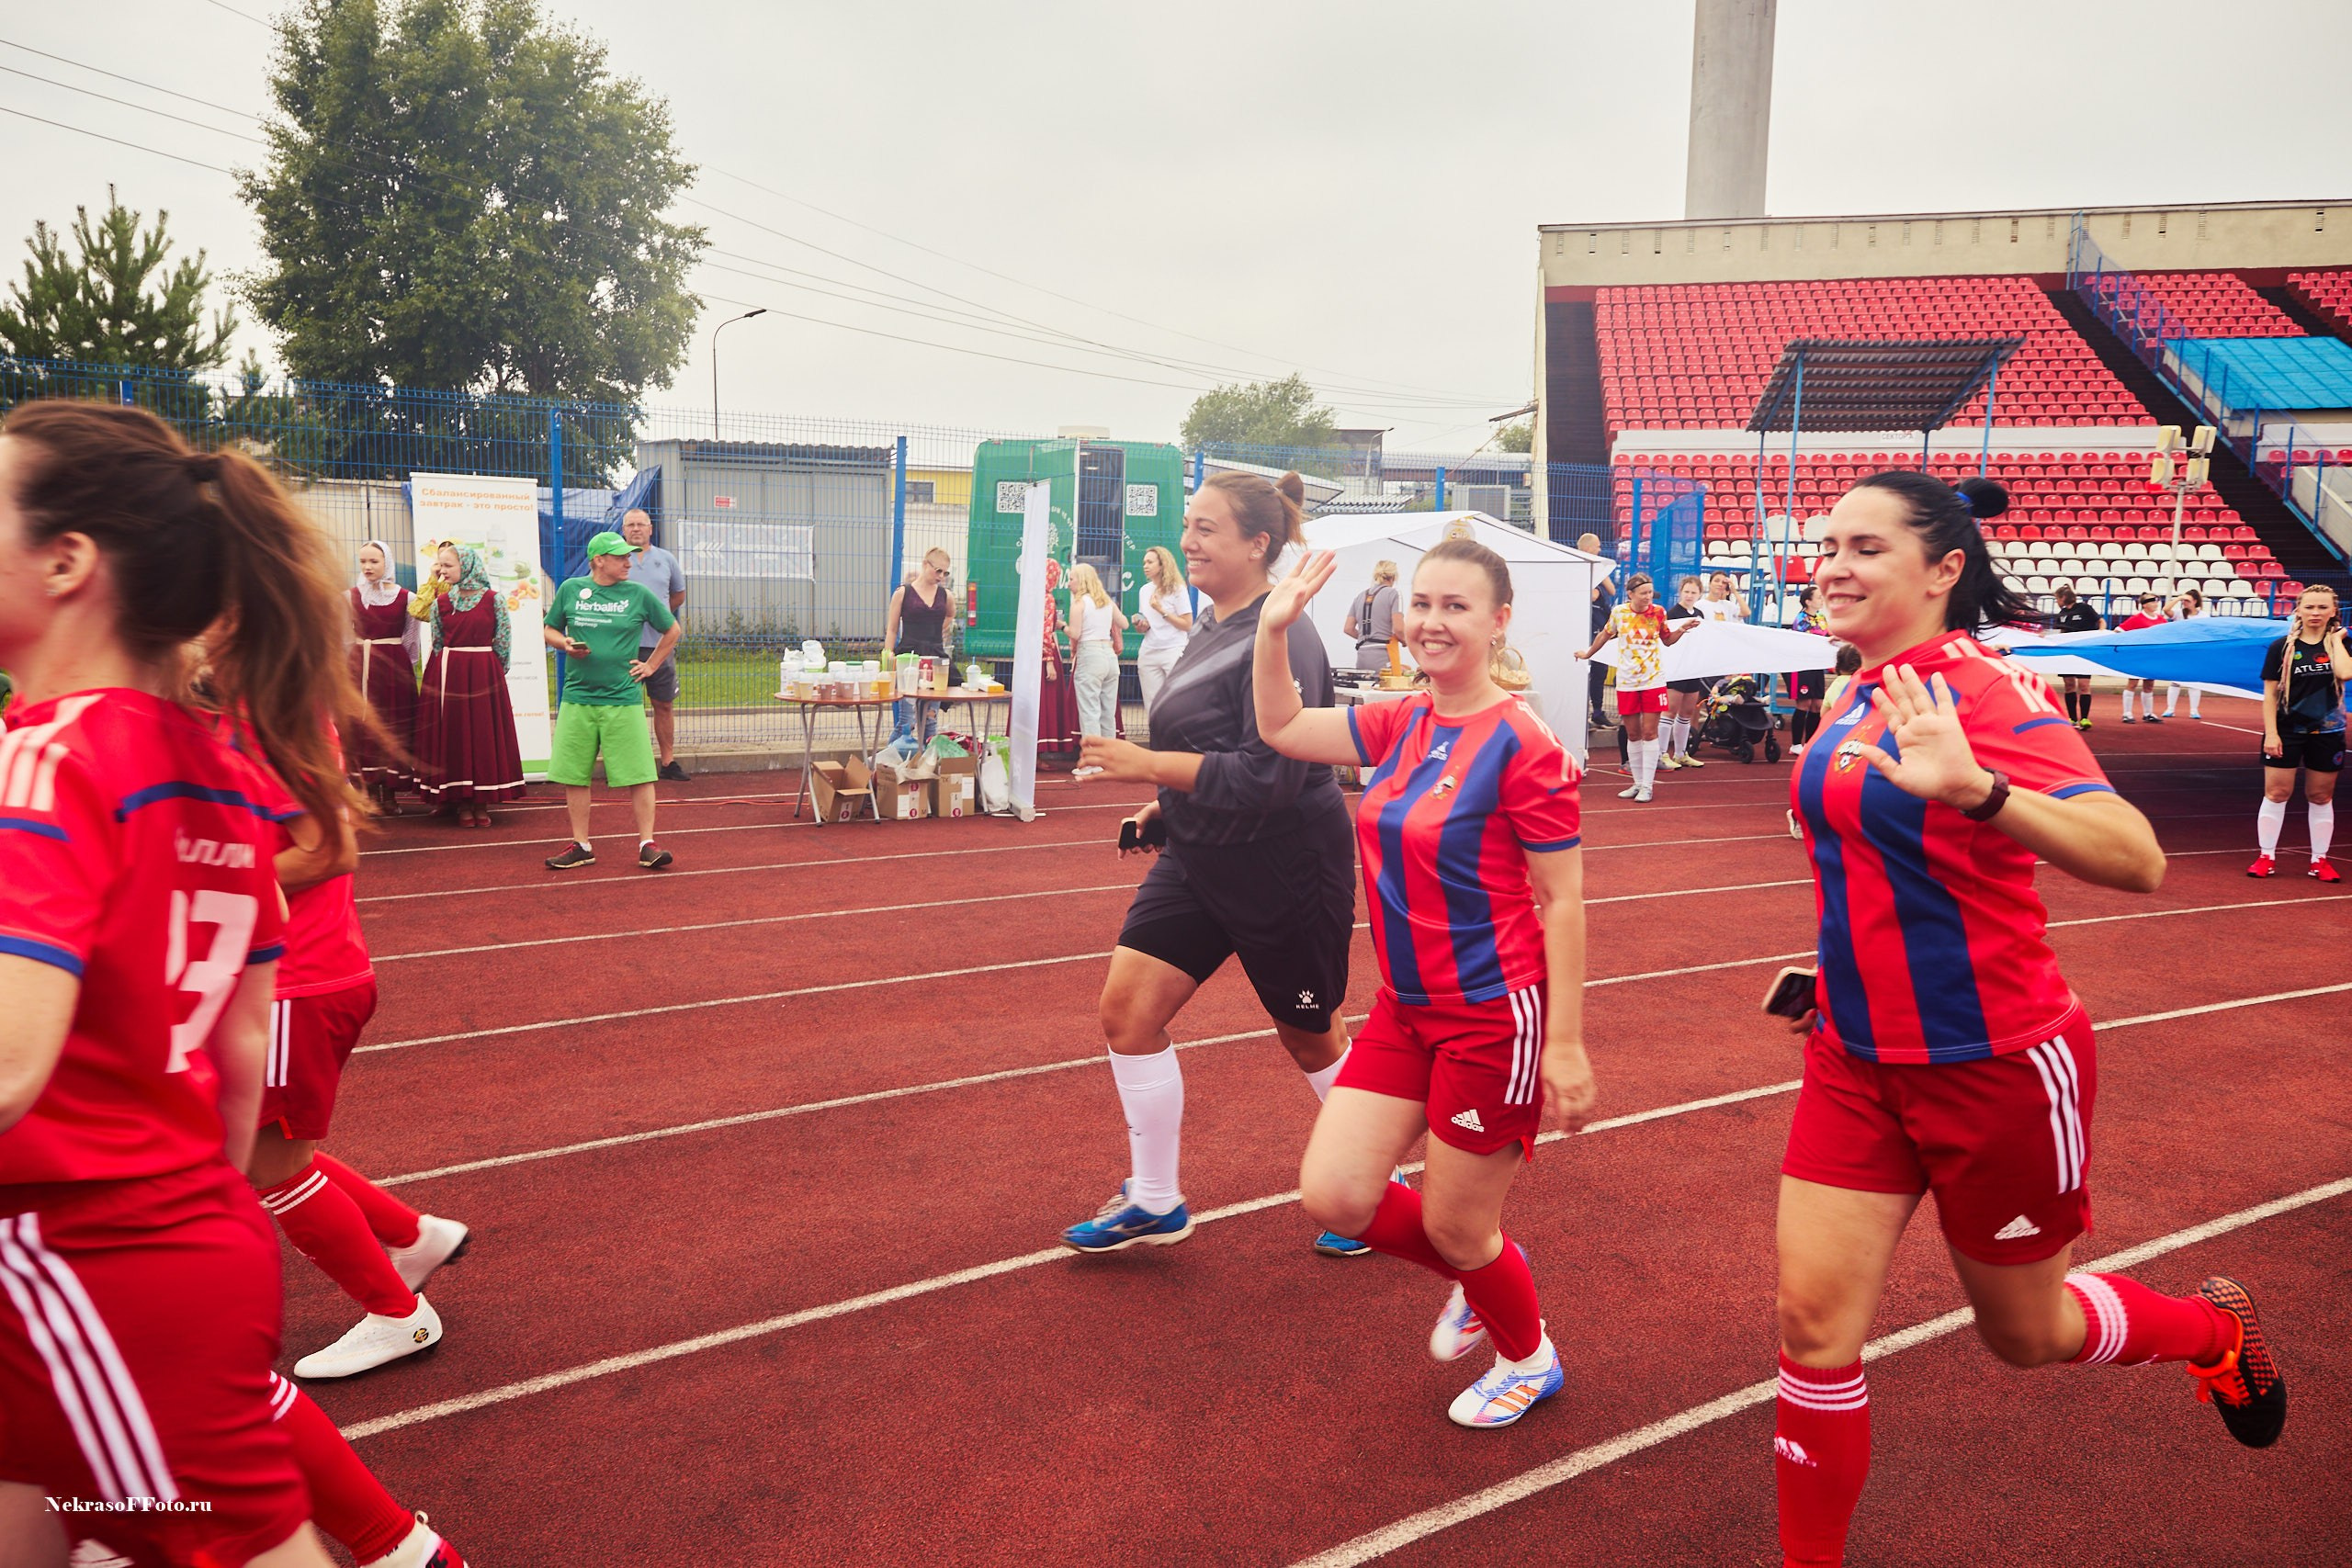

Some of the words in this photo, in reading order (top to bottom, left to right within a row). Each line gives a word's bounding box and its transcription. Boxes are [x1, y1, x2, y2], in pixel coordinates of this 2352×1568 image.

[422, 488, 530, 501] Сбалансированный
[420, 500, 463, 509] завтрак
[494, 503, 533, 512] просто!
[575, 600, 625, 613] Herbalife
[1658, 693, 1668, 706] 15
[1451, 1116, 1485, 1133] adidas
